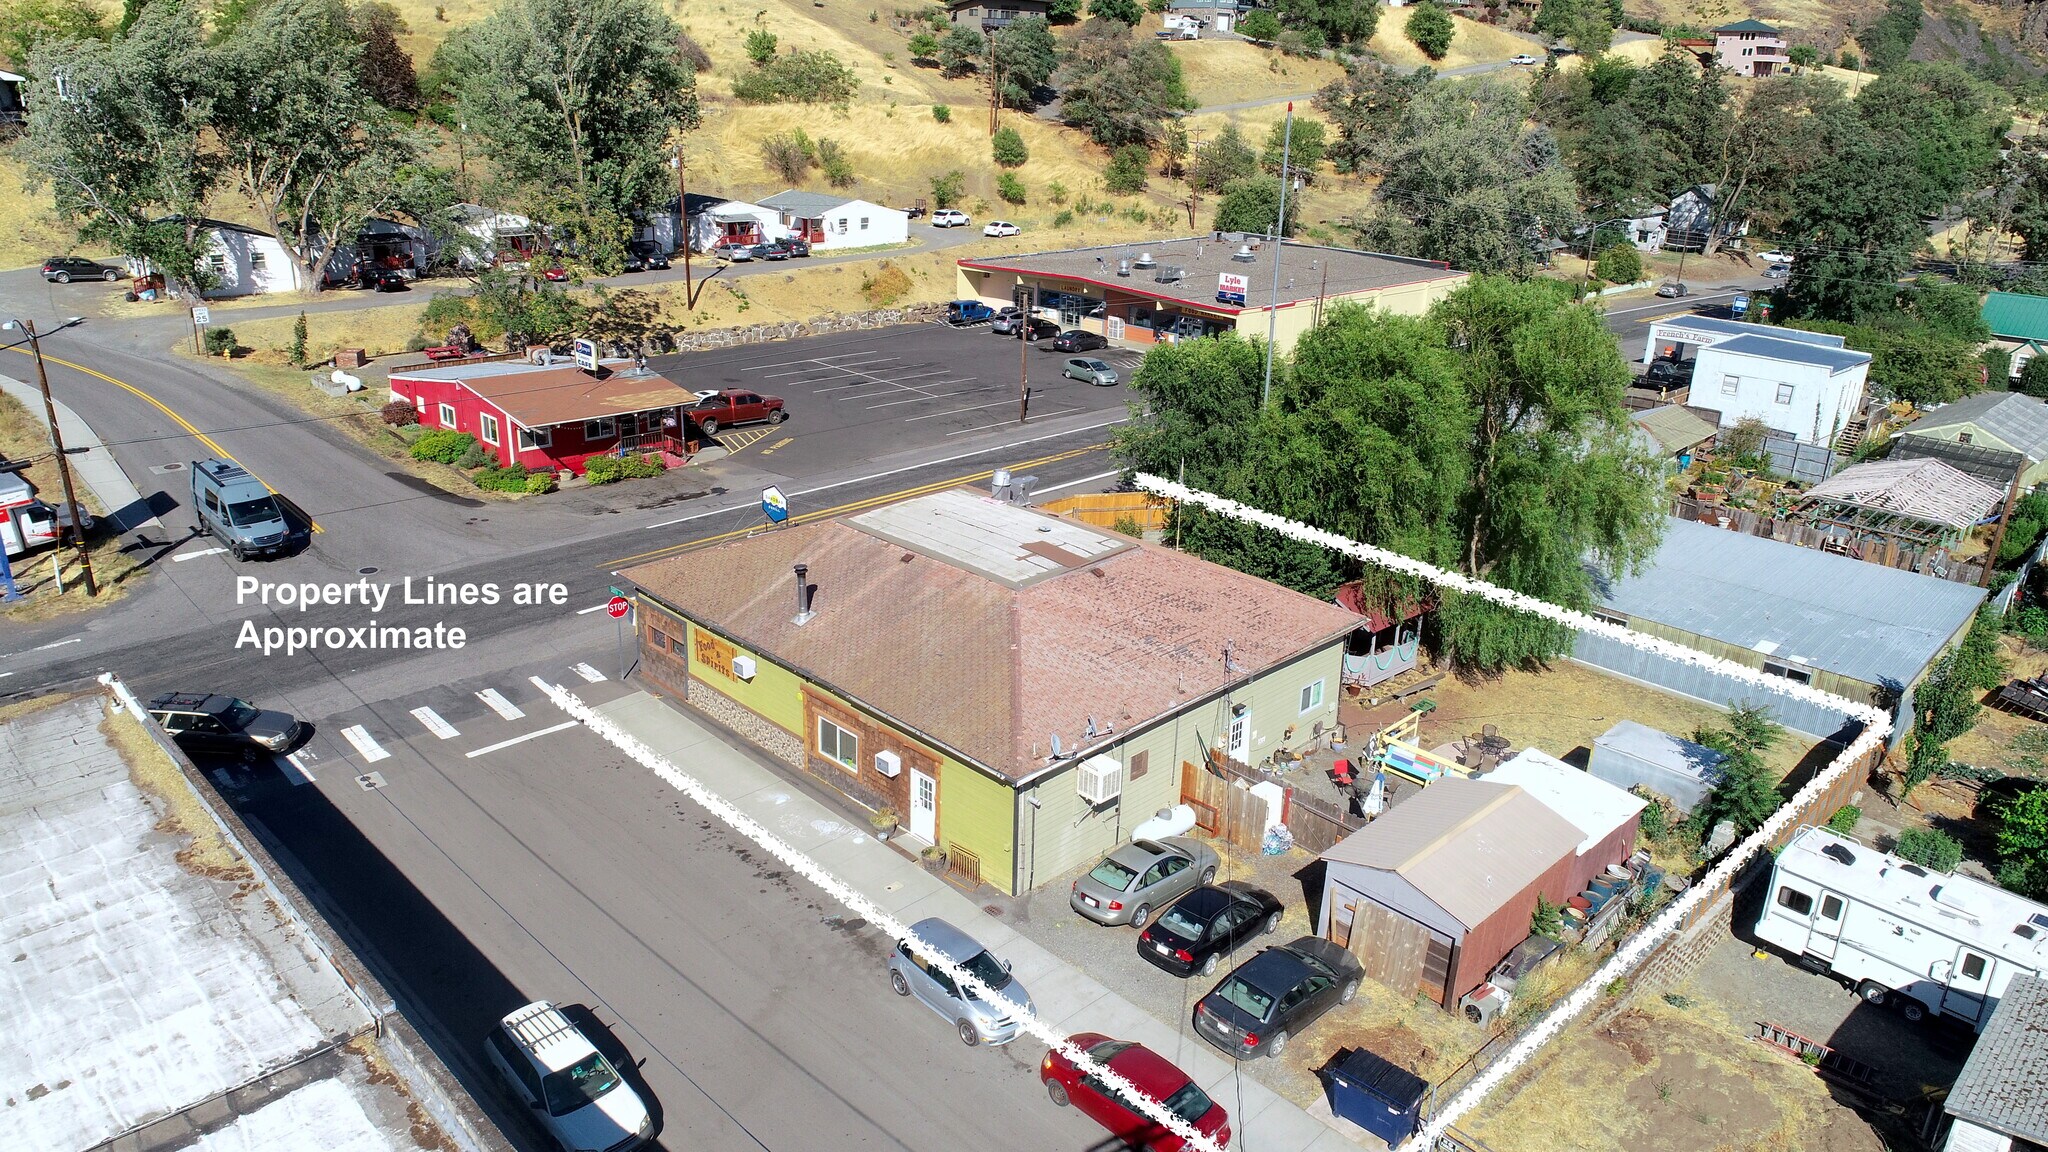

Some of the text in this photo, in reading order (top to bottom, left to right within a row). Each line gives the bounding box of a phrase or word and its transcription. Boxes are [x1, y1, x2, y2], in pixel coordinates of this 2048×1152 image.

[1225, 275, 1241, 285] Lyle
[1219, 284, 1245, 294] MARKET
[1658, 329, 1713, 343] French's Farm
[577, 359, 592, 369] CAFE
[609, 601, 628, 613] STOP
[697, 639, 715, 652] Food
